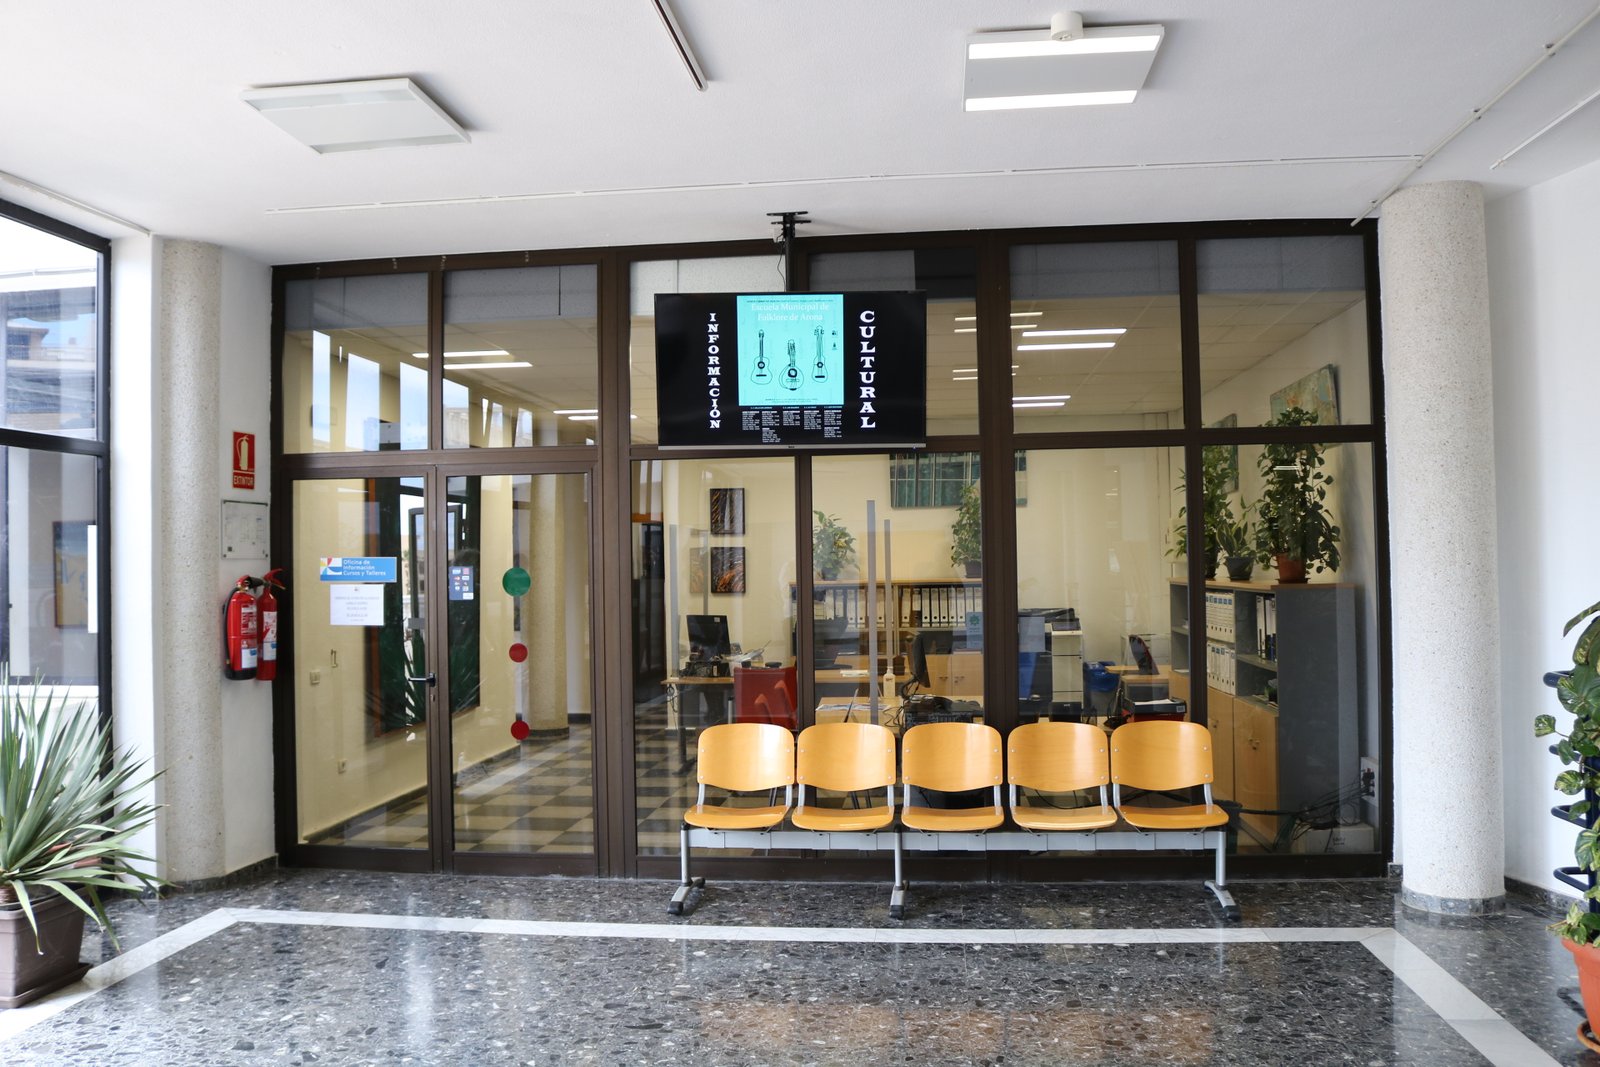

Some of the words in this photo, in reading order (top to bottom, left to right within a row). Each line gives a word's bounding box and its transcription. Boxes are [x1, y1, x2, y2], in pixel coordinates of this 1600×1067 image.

[780, 303, 819, 312] Municipal
[819, 303, 829, 311] de
[789, 313, 798, 321] de
[800, 313, 823, 321] Arona
[707, 312, 721, 429] INFORMACIÓN
[859, 310, 876, 429] CULTURAL
[233, 475, 254, 486] EXTINTOR
